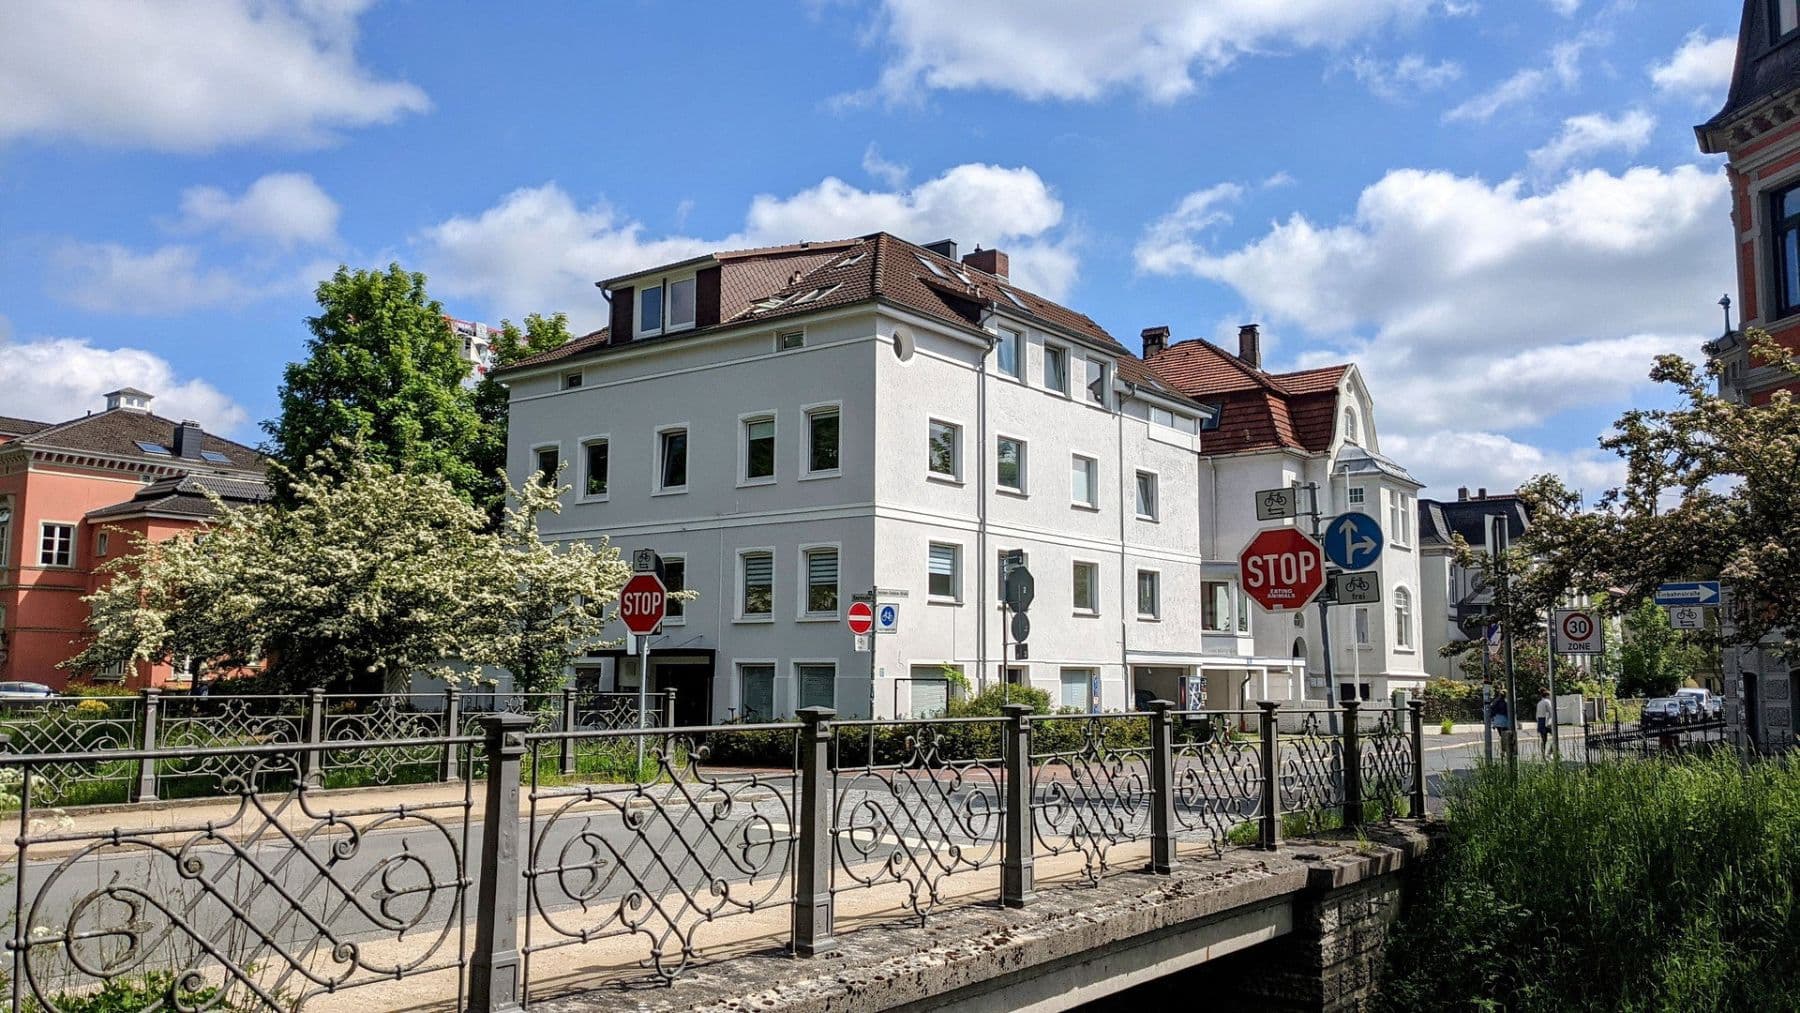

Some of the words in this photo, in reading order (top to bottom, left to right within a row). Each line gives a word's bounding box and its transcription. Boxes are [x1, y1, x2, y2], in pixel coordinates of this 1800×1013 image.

[1247, 550, 1315, 588] STOP
[1352, 592, 1366, 600] frei
[623, 592, 662, 616] STOP
[1569, 620, 1587, 634] 30
[1567, 643, 1591, 651] ZONE
